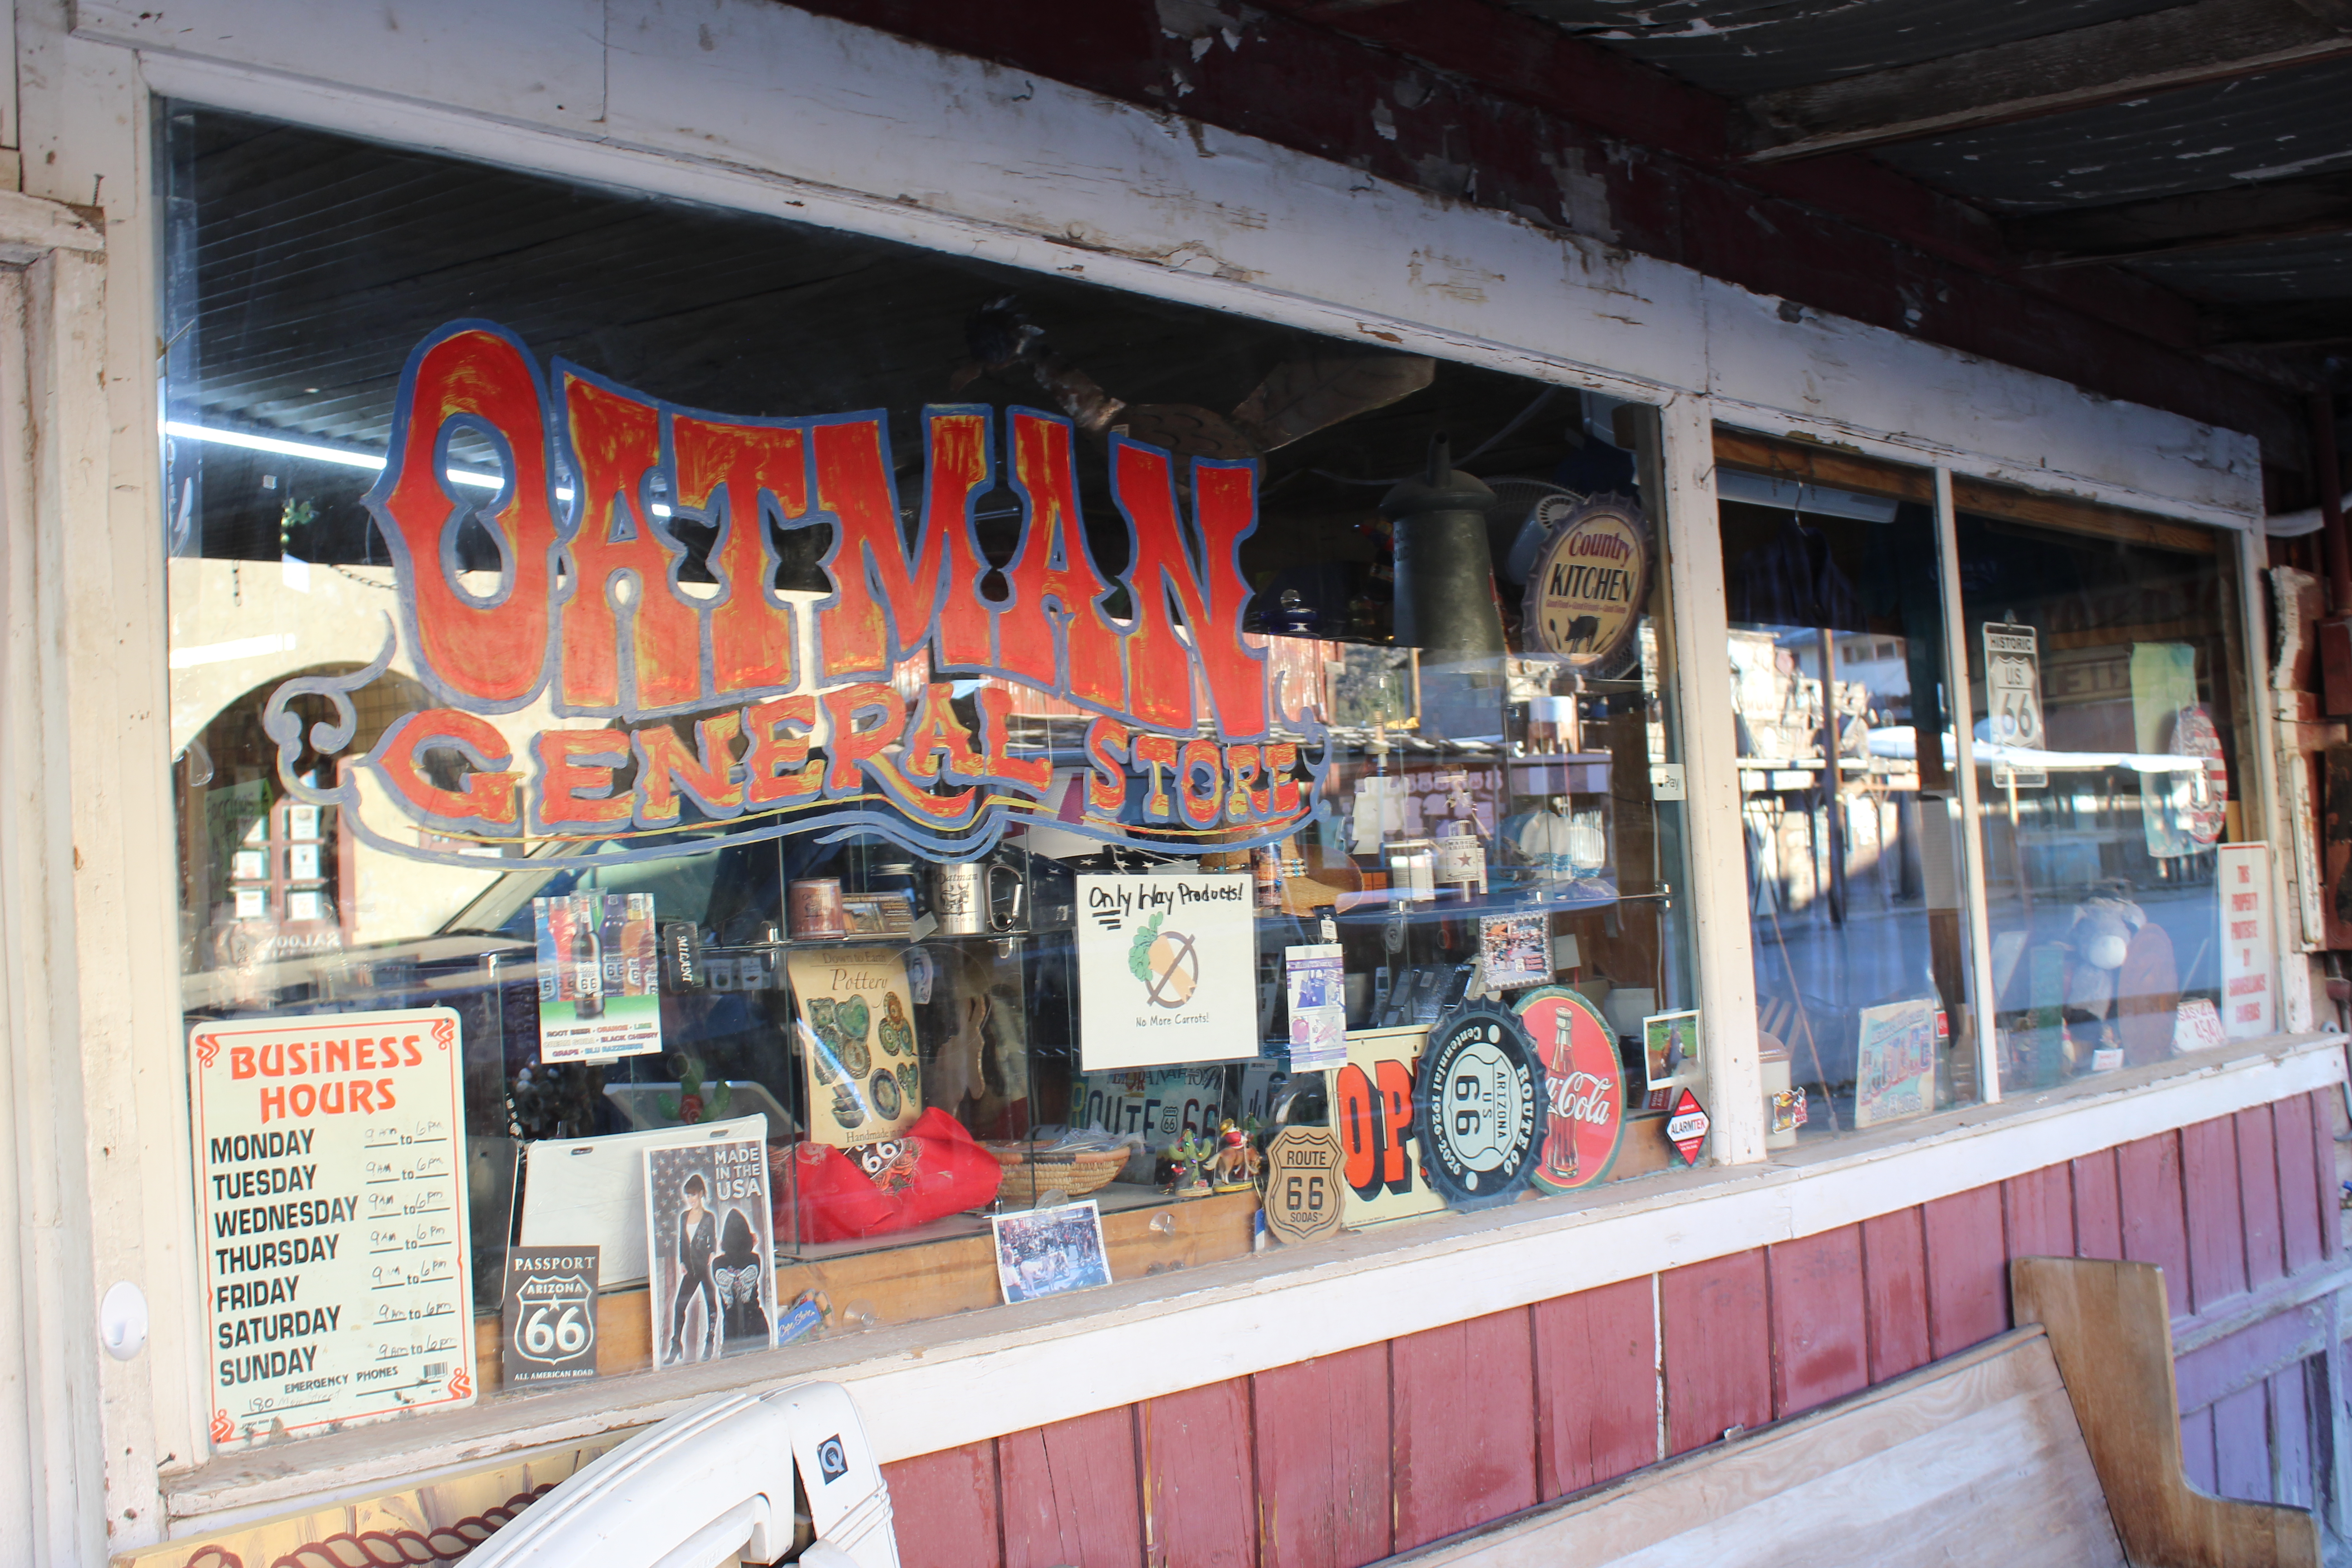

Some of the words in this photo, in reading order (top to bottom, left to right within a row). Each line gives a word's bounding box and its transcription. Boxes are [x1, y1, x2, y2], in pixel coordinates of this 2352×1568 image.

[360, 318, 1269, 743] OATMAN
[1568, 531, 1634, 567] Country
[1549, 563, 1636, 602] KITCHEN
[1990, 637, 2032, 651] HISTORIC
[2000, 693, 2033, 738] 66
[362, 681, 1054, 835] GENERAL
[1083, 715, 1299, 830] STORE
[936, 873, 978, 885] Oatman
[1089, 882, 1132, 916] Only
[1178, 882, 1243, 906] Products!
[823, 953, 853, 964] Down
[580, 979, 598, 990] 66
[829, 968, 888, 1008] Pottery
[1136, 1017, 1146, 1028] No
[1150, 1015, 1172, 1026] More
[1174, 1012, 1209, 1024] Carrots!
[1432, 1026, 1482, 1091] Centennial
[260, 1078, 396, 1125] HOURS
[1455, 1075, 1480, 1136] 66
[1496, 1071, 1508, 1139] ARIZONA
[1516, 1063, 1535, 1150] ROUTE
[846, 1128, 889, 1143] Handmade
[1164, 1119, 1175, 1130] 66
[1337, 1059, 1432, 1202] OP
[1431, 1094, 1462, 1176] 1926-2026
[1671, 1117, 1706, 1135] ALARMTEK
[211, 1127, 315, 1164] MONDAY
[400, 1134, 412, 1145] to
[715, 1147, 760, 1166] MADE
[1287, 1149, 1326, 1166] ROUTE
[1503, 1150, 1521, 1176] 66
[213, 1163, 318, 1201] TUESDAY
[402, 1169, 415, 1180] to
[715, 1166, 730, 1179] IN
[733, 1164, 761, 1177] THE
[716, 1177, 762, 1201] USA
[1286, 1176, 1323, 1210] 66
[214, 1195, 359, 1239] WEDNESDAY
[403, 1205, 416, 1215] to
[216, 1233, 340, 1275] THURSDAY
[406, 1239, 417, 1250] to
[514, 1256, 596, 1271] PASSPORT
[217, 1275, 299, 1313] FRIDAY
[407, 1274, 419, 1285] to
[526, 1283, 583, 1295] ARIZONA
[218, 1305, 341, 1350] SATURDAY
[408, 1309, 421, 1320] to
[525, 1306, 585, 1354] 66
[220, 1345, 318, 1387] SUNDAY
[412, 1344, 423, 1355] to
[284, 1374, 349, 1395] EMERGENCY
[356, 1366, 399, 1382] PHONES
[530, 1370, 572, 1380] AMERICAN
[573, 1368, 594, 1377] ROAD
